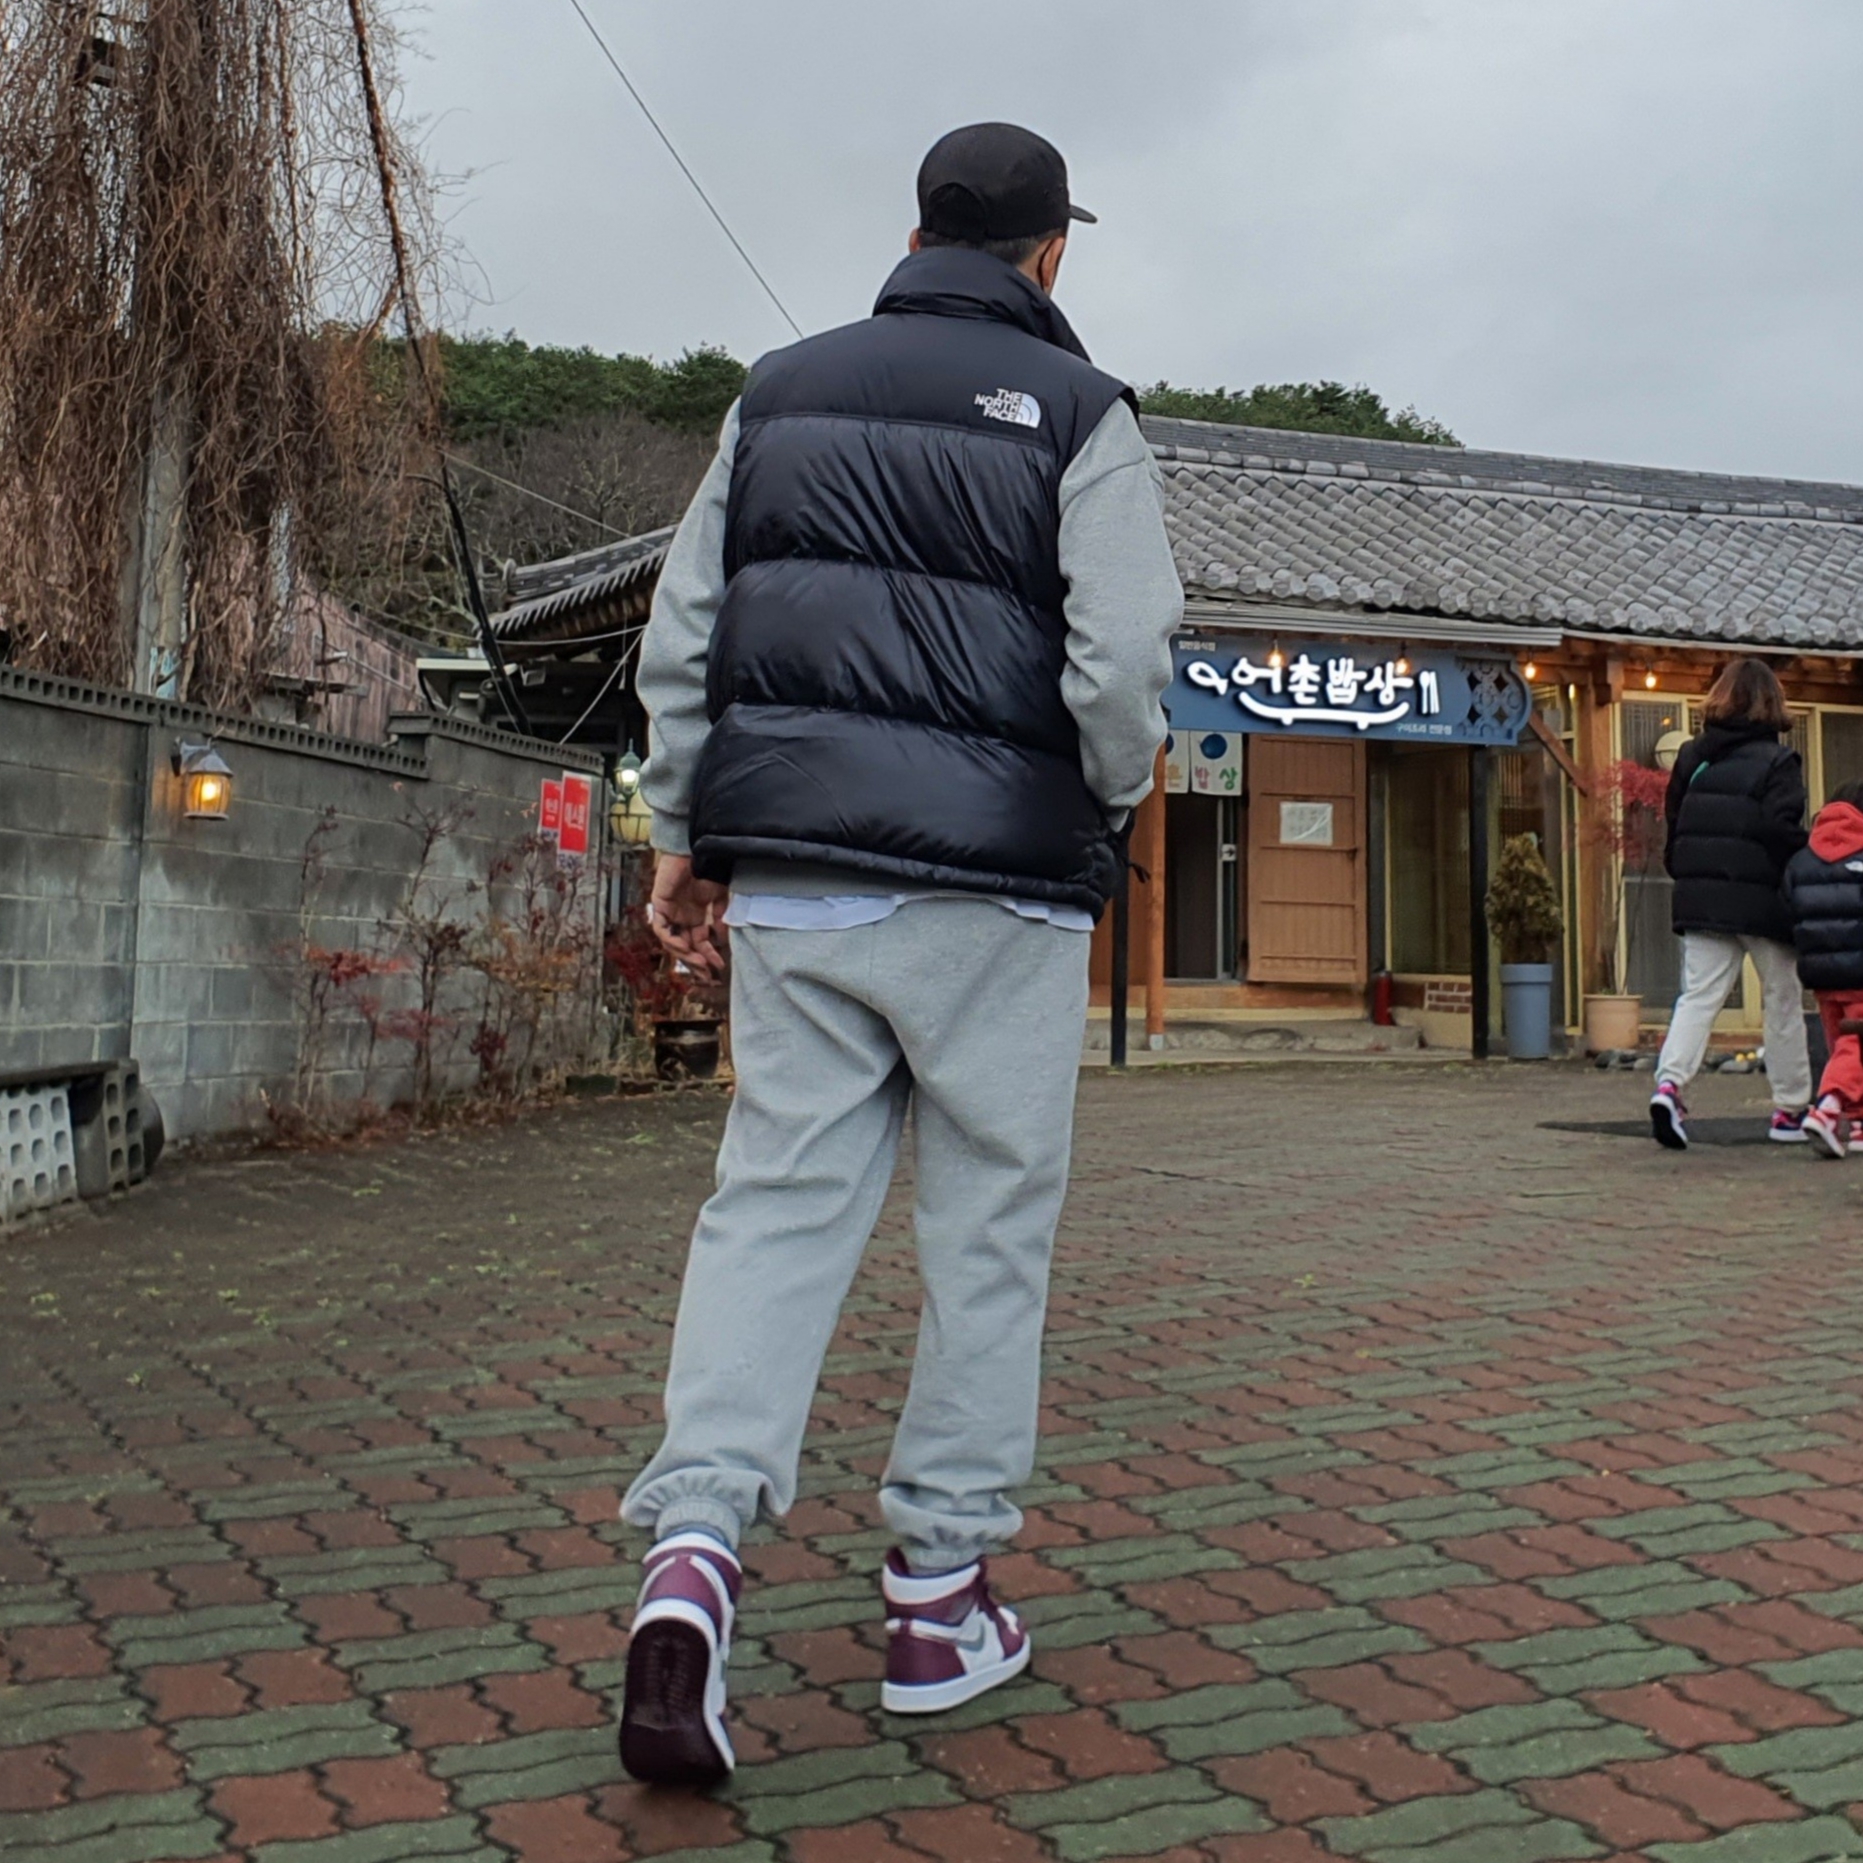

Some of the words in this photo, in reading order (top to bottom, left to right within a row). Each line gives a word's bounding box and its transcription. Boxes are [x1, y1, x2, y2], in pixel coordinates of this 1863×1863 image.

[974, 393, 1020, 414] NORTH
[996, 388, 1022, 403] THE
[983, 406, 1017, 422] FACE
[1231, 654, 1414, 705] 어촌밥상
